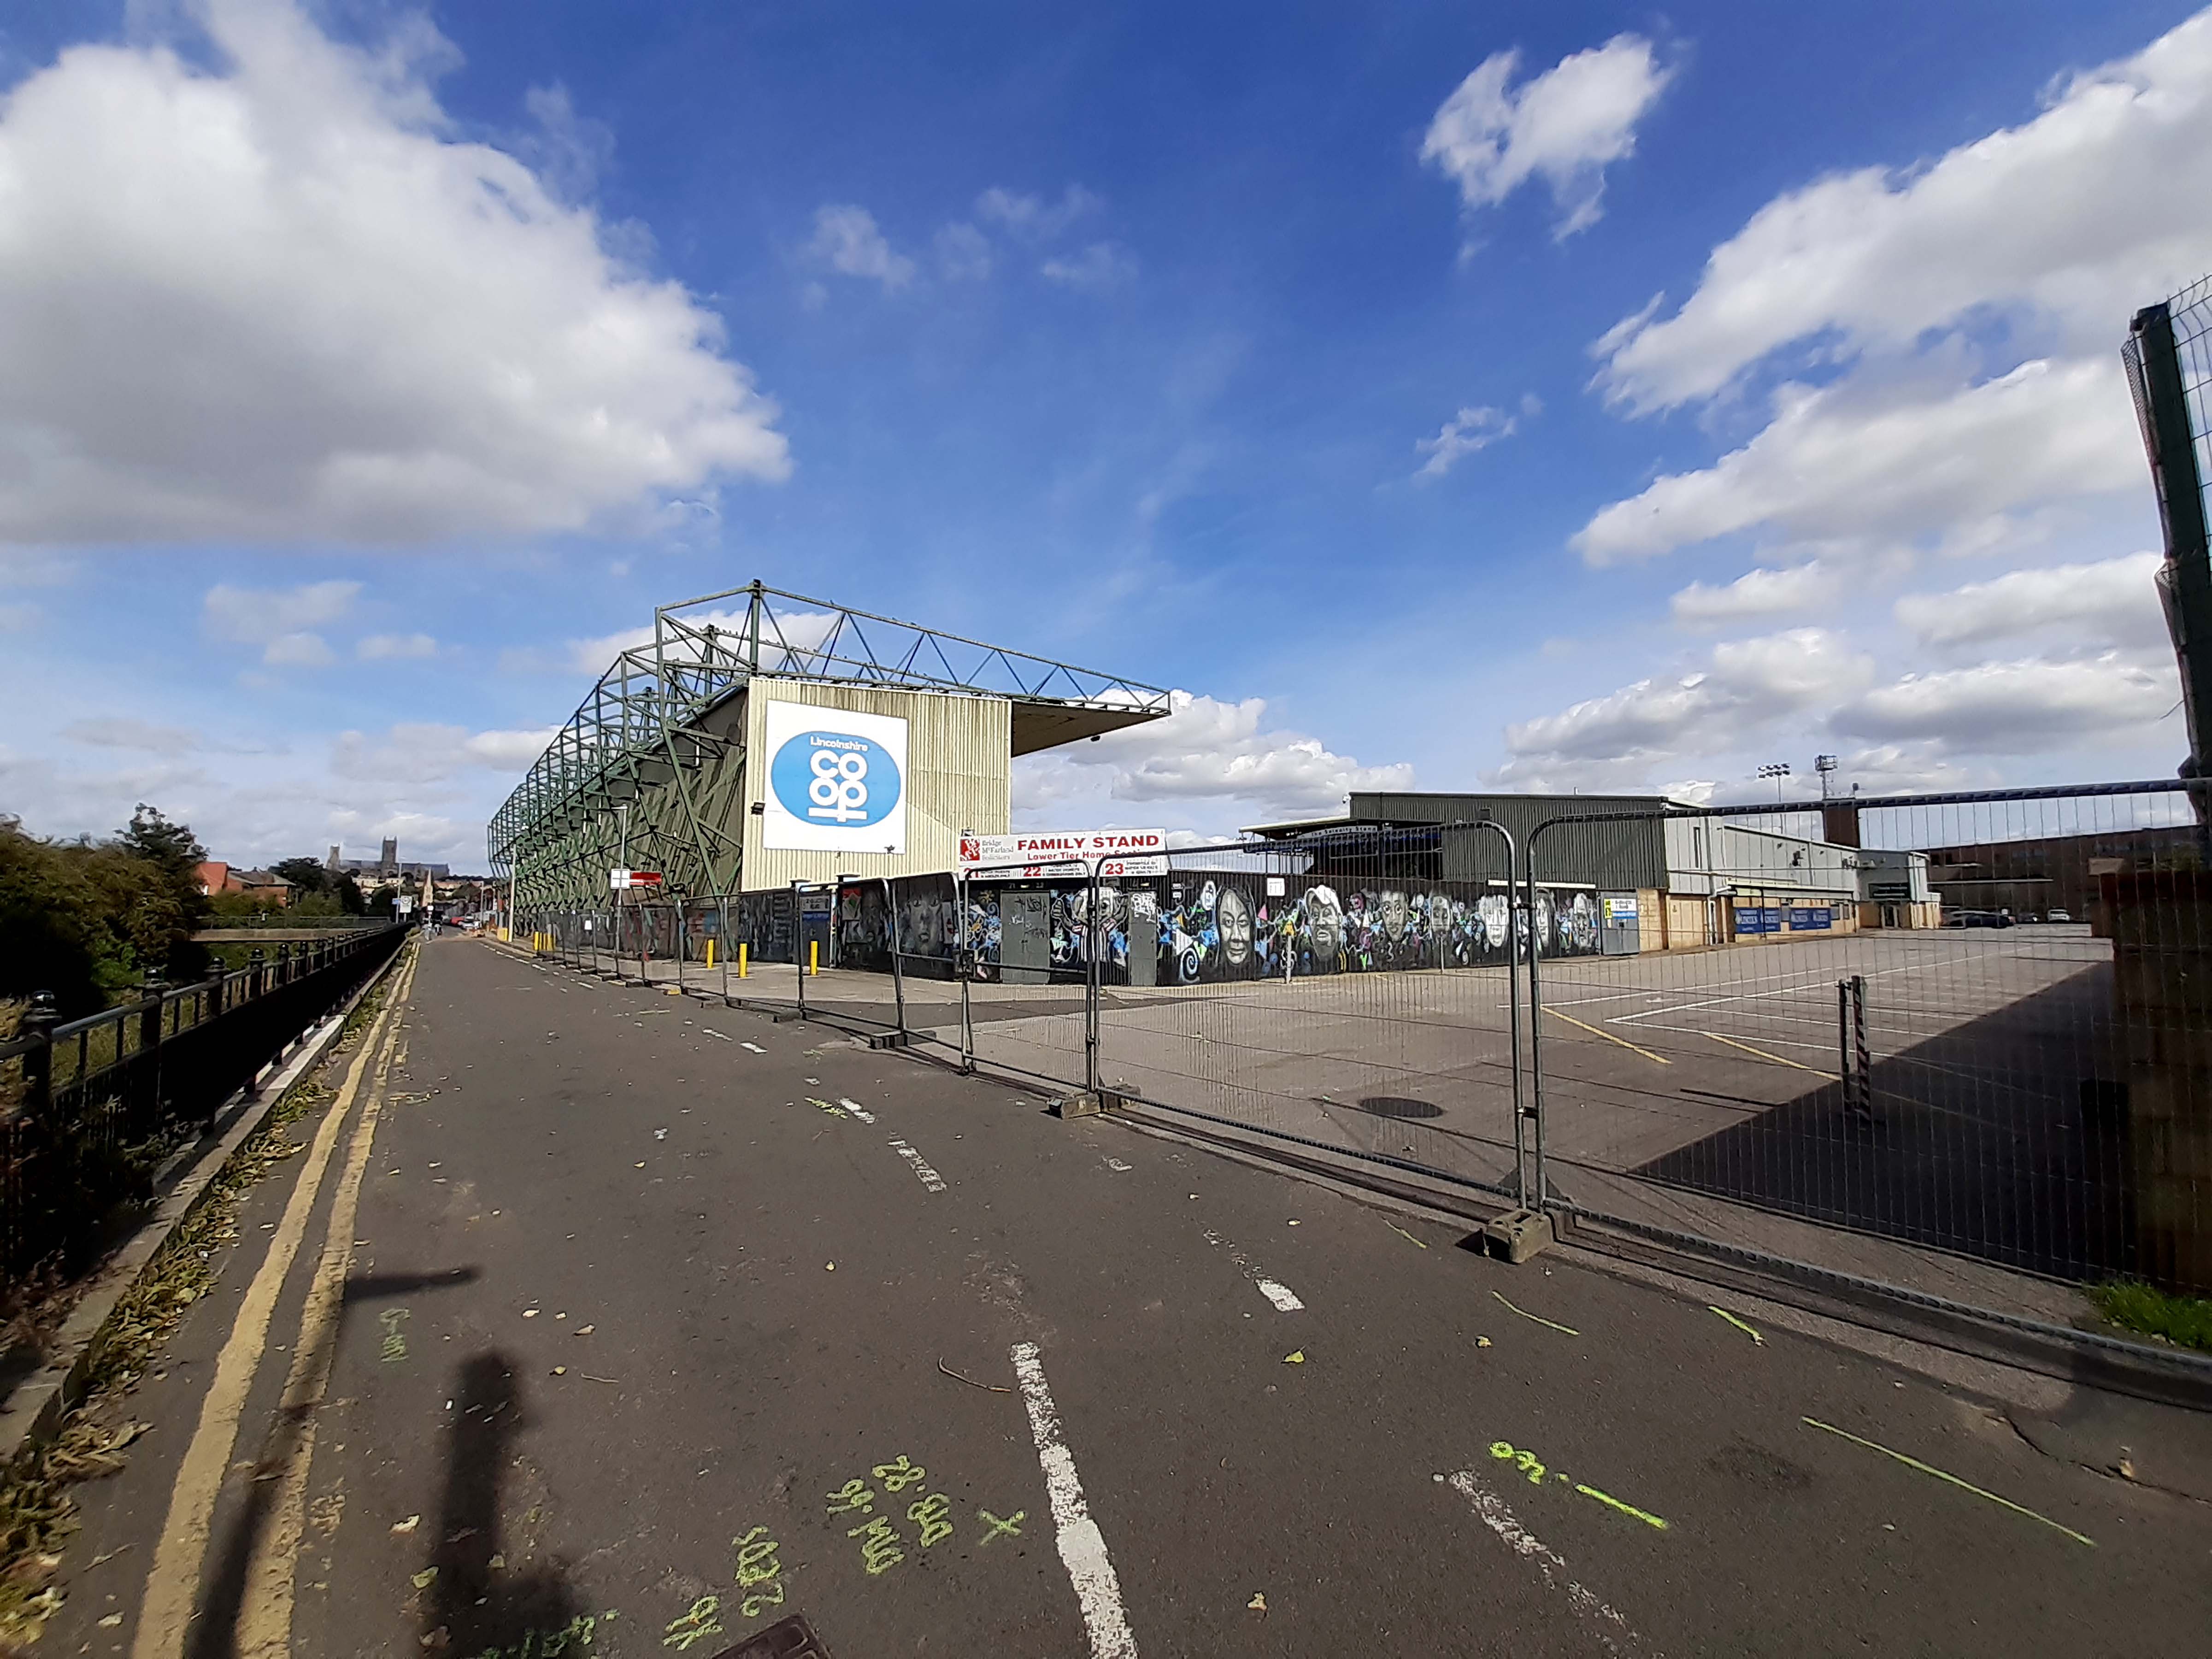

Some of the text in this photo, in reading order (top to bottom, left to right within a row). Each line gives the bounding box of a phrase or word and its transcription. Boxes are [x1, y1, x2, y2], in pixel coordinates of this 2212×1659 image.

[810, 736, 868, 751] Lincolnshire
[1017, 835, 1159, 851] FAMILY STAND
[1028, 853, 1057, 861] Lower
[1061, 852, 1079, 860] Tier
[1082, 851, 1111, 859] Home
[1023, 866, 1041, 877] 22
[1105, 863, 1124, 875] 23
